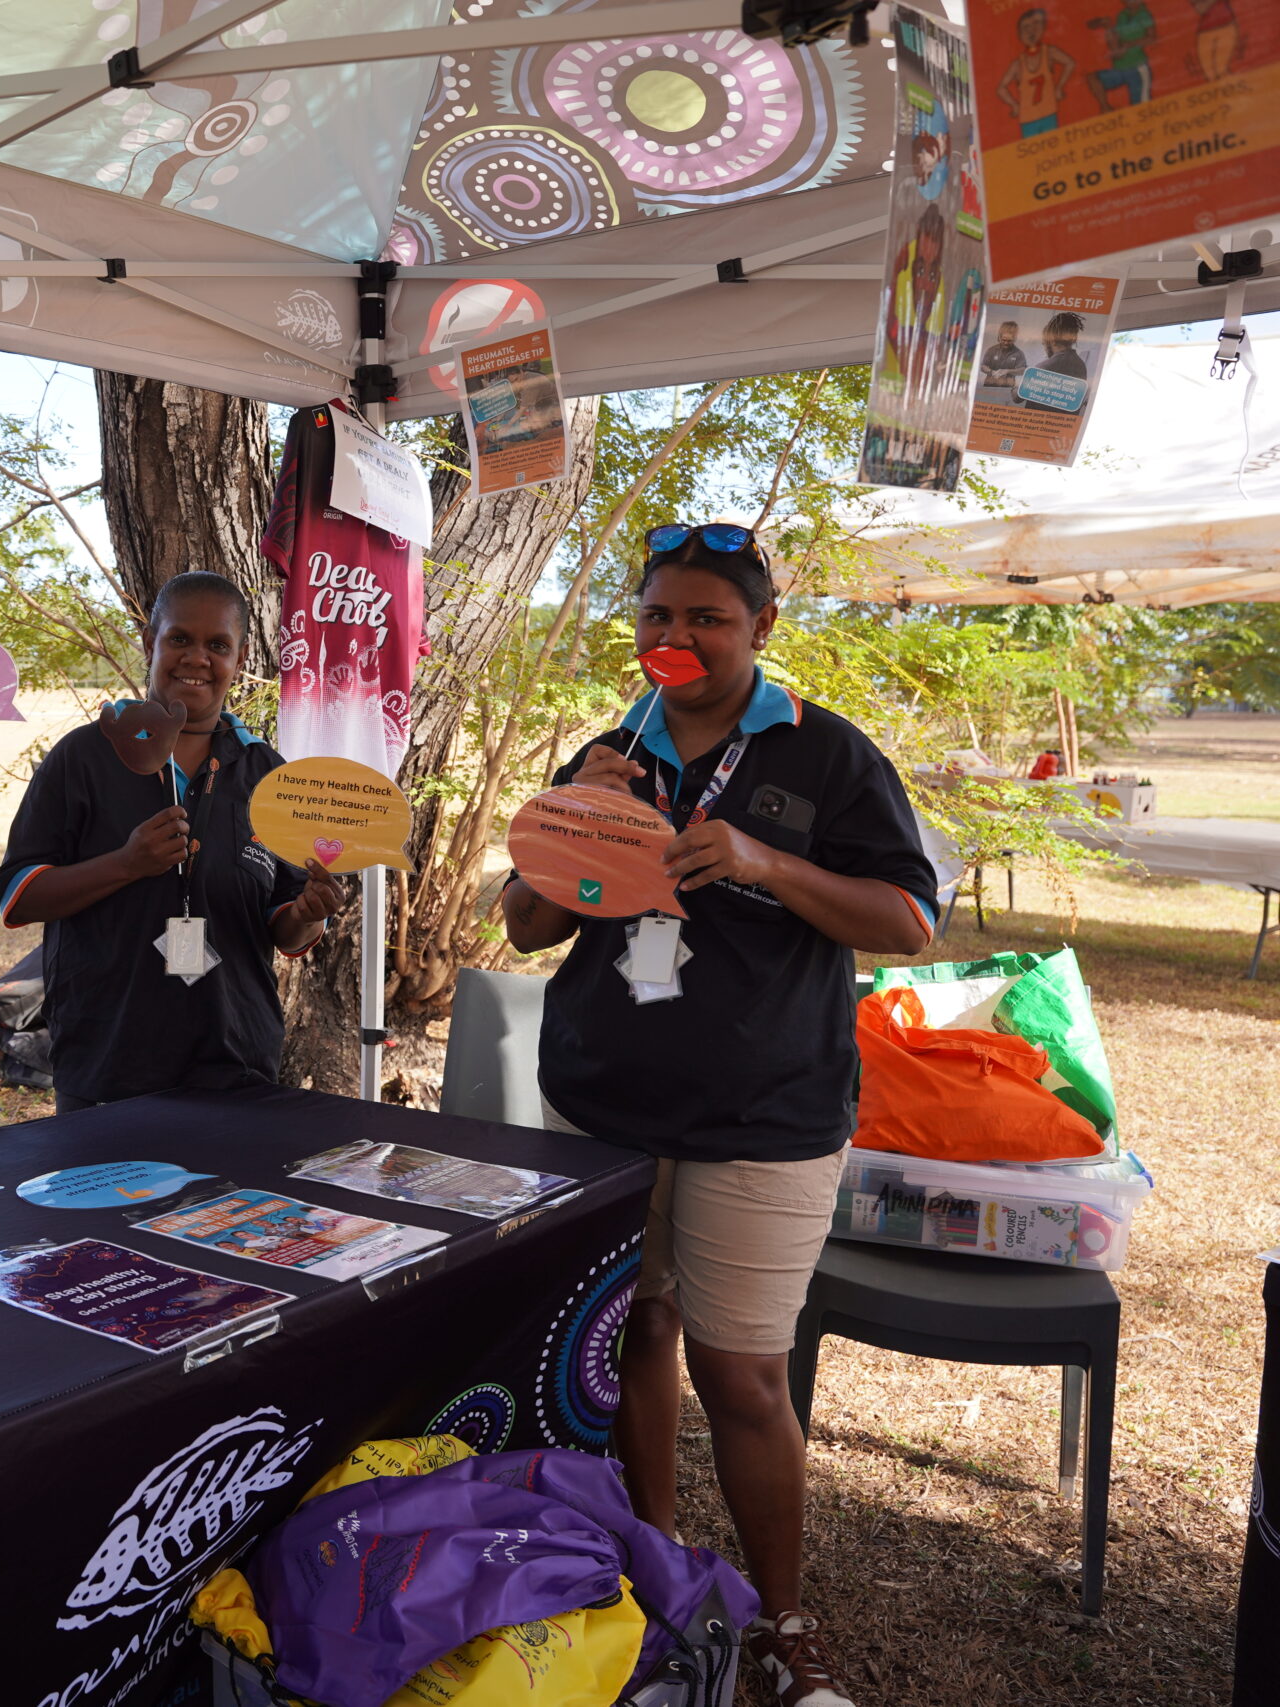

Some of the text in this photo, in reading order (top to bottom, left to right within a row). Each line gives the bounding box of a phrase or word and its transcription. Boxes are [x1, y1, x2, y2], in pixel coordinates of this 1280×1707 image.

[1017, 136, 1060, 158] Sore
[1138, 98, 1181, 123] skin
[1033, 133, 1247, 200] Go to the clinic.
[1035, 151, 1077, 176] joint
[1083, 140, 1126, 161] pain
[1133, 131, 1155, 146] or
[990, 290, 1104, 310] HEART DISEASE TIP
[467, 345, 516, 366] RHEUMATIC
[468, 347, 545, 375] HEART DISEASE TIP
[322, 511, 343, 521] ORIGIN
[277, 773, 392, 797] I have my Health Check
[276, 792, 389, 815] every year because my
[541, 802, 567, 816] have
[568, 809, 586, 820] my
[587, 810, 624, 824] Health
[626, 816, 660, 831] Check
[292, 810, 369, 828] health matters!
[540, 822, 651, 849] every year because...
[1004, 1208, 1018, 1249] COLOURED
[1016, 1214, 1028, 1245] PENCILS
[44, 1267, 147, 1301] Stay healthy,
[70, 1274, 158, 1304] stay strong
[78, 1304, 101, 1316] Get
[106, 1296, 127, 1307] 715
[125, 1287, 159, 1301] health
[157, 1276, 189, 1290] check
